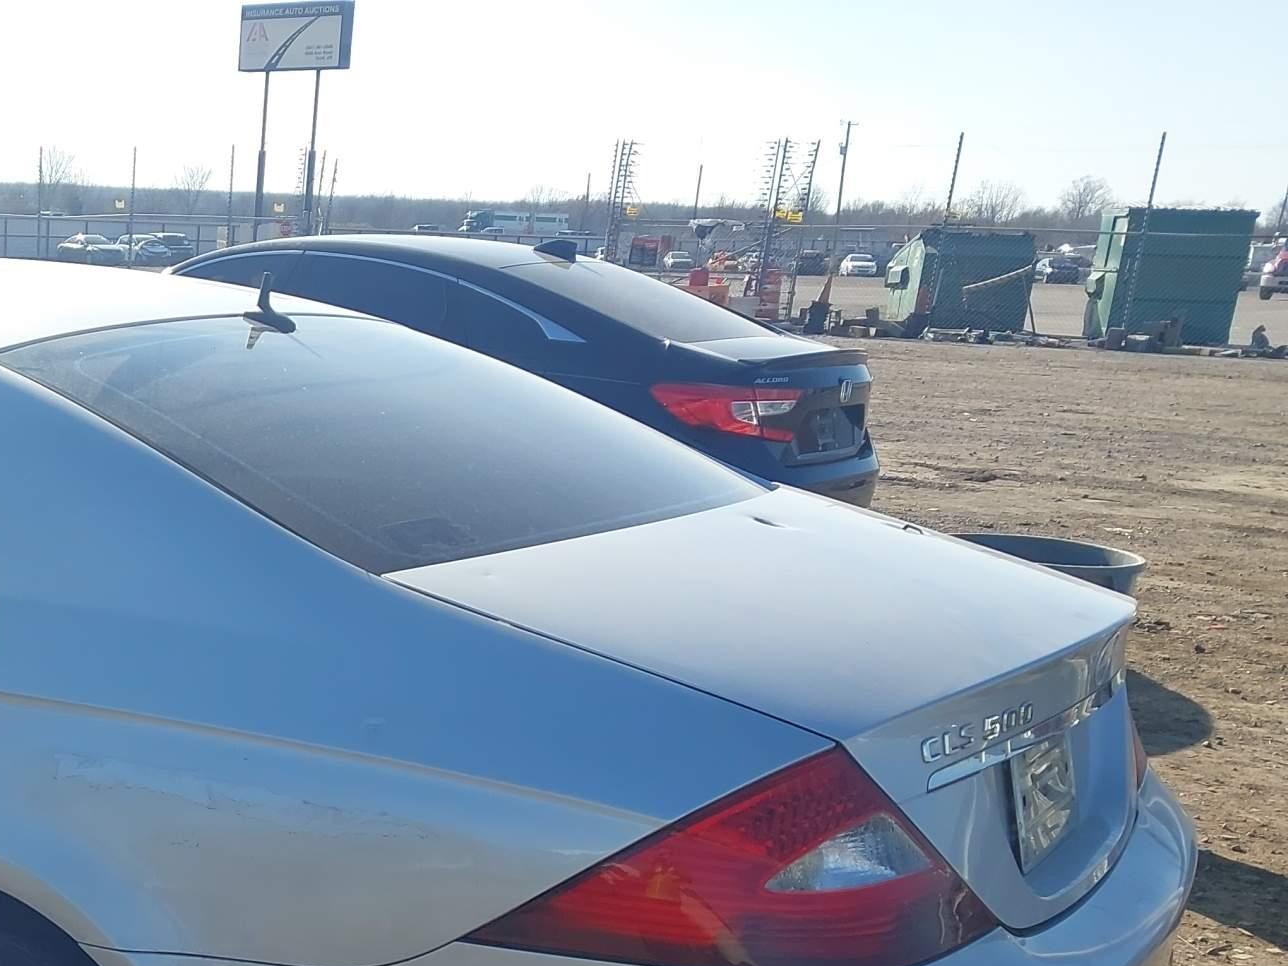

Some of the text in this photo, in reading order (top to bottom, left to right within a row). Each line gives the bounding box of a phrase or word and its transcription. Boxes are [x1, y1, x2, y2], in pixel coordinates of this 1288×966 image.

[245, 5, 339, 17] INSURANCE AUTO AUCTIONS
[754, 376, 789, 384] ACCORD
[921, 703, 1033, 764] CLS 500
